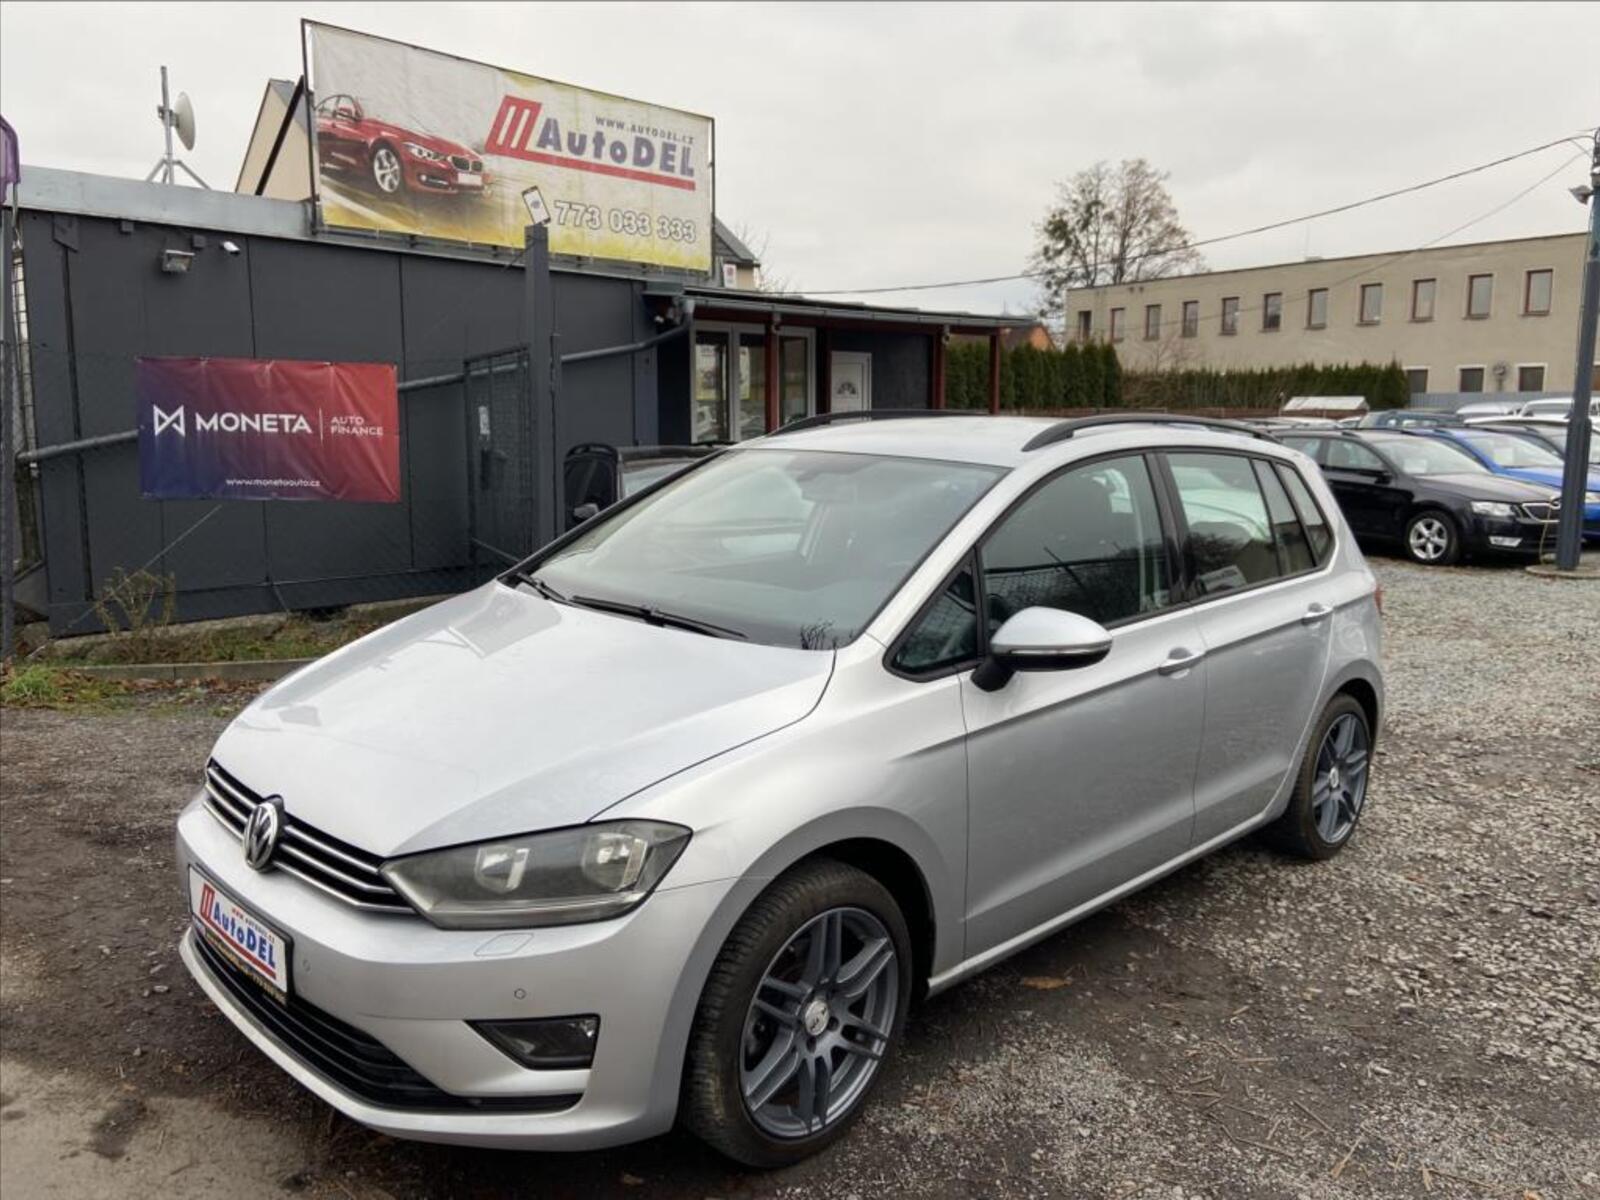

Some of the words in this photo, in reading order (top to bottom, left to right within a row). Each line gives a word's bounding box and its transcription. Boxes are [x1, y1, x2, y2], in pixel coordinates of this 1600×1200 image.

[536, 117, 695, 178] AutoDEL
[554, 200, 602, 230] 773
[608, 208, 652, 237] 033
[657, 215, 696, 244] 333
[195, 412, 313, 434] MONETA
[330, 416, 365, 426] AUTO
[330, 425, 384, 436] FINANCE
[213, 901, 276, 969] AutoDEL
